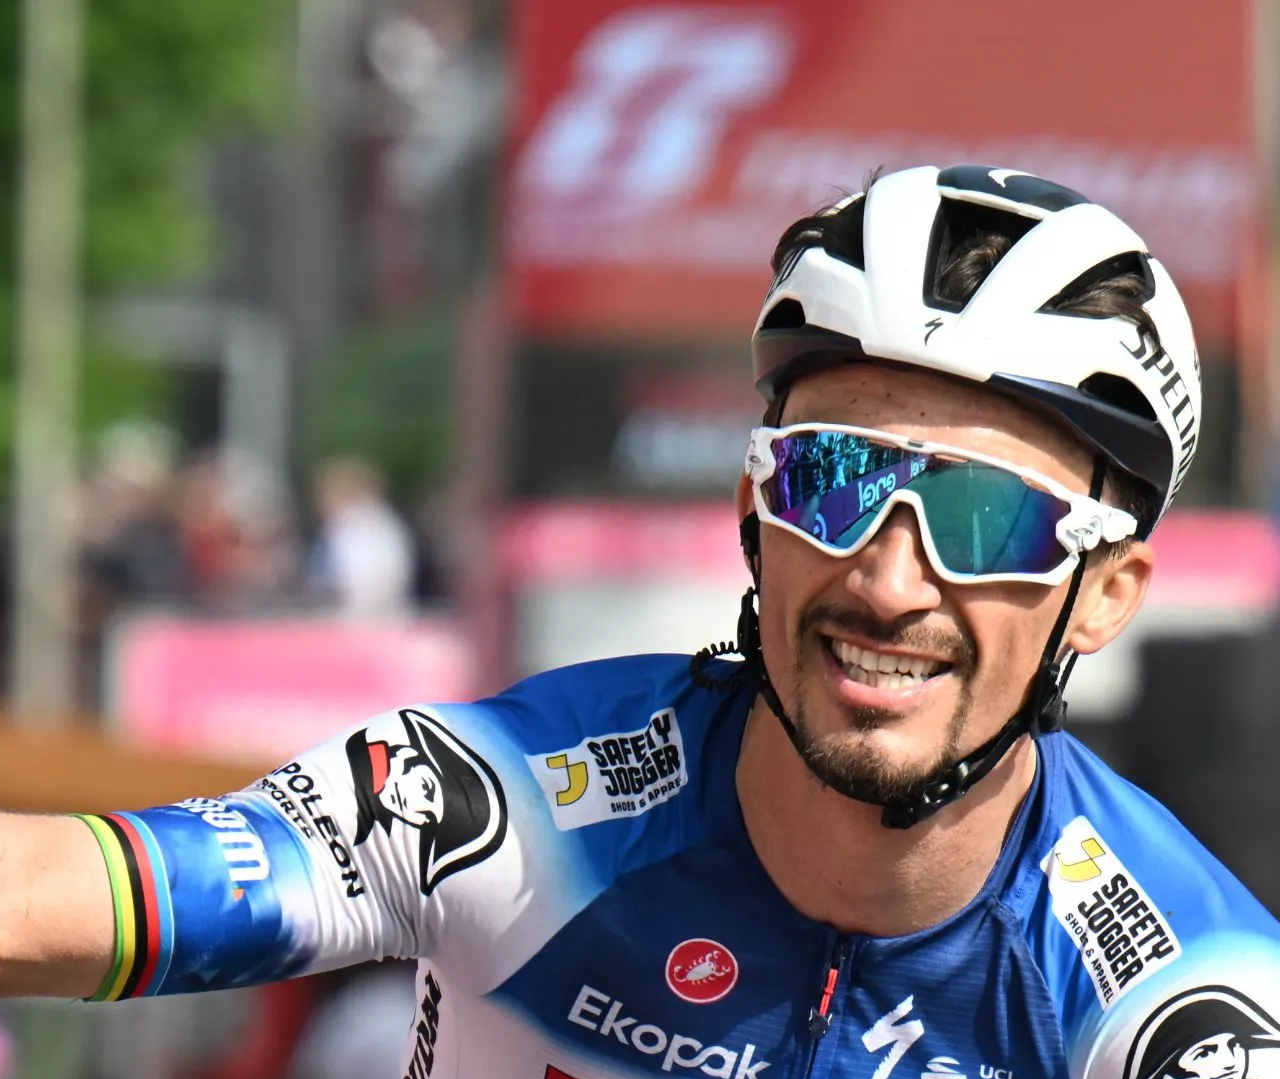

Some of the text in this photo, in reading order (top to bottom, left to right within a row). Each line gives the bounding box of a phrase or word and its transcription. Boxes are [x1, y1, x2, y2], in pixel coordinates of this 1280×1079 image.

[587, 713, 671, 768] SAFETY
[599, 744, 680, 797] JOGGER
[611, 801, 636, 813] SHOES
[1078, 891, 1144, 990] JOGGER
[1101, 873, 1174, 962] SAFETY
[1065, 912, 1114, 1003] SHOES & APPAREL
